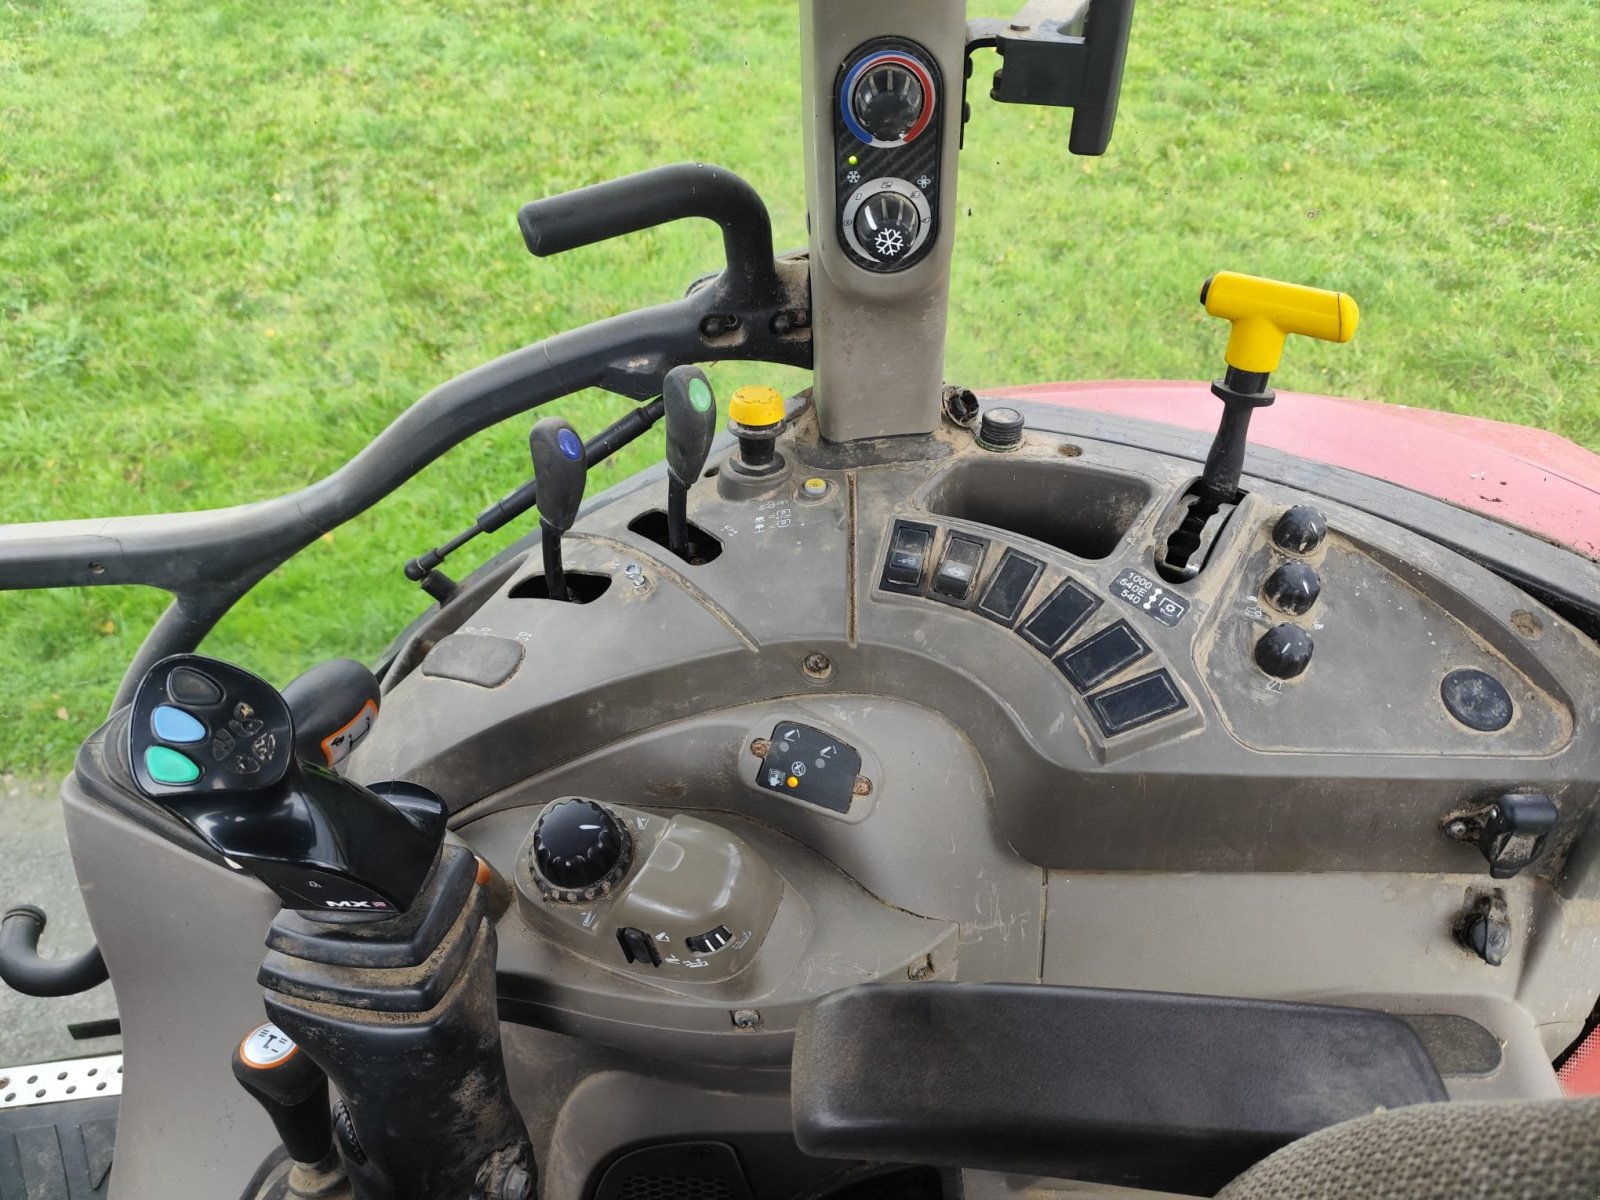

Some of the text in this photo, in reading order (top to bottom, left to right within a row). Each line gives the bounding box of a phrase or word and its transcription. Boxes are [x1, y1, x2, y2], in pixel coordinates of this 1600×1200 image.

[1120, 578, 1147, 598] 540E
[1128, 572, 1153, 589] 1000
[1120, 589, 1141, 604] 540
